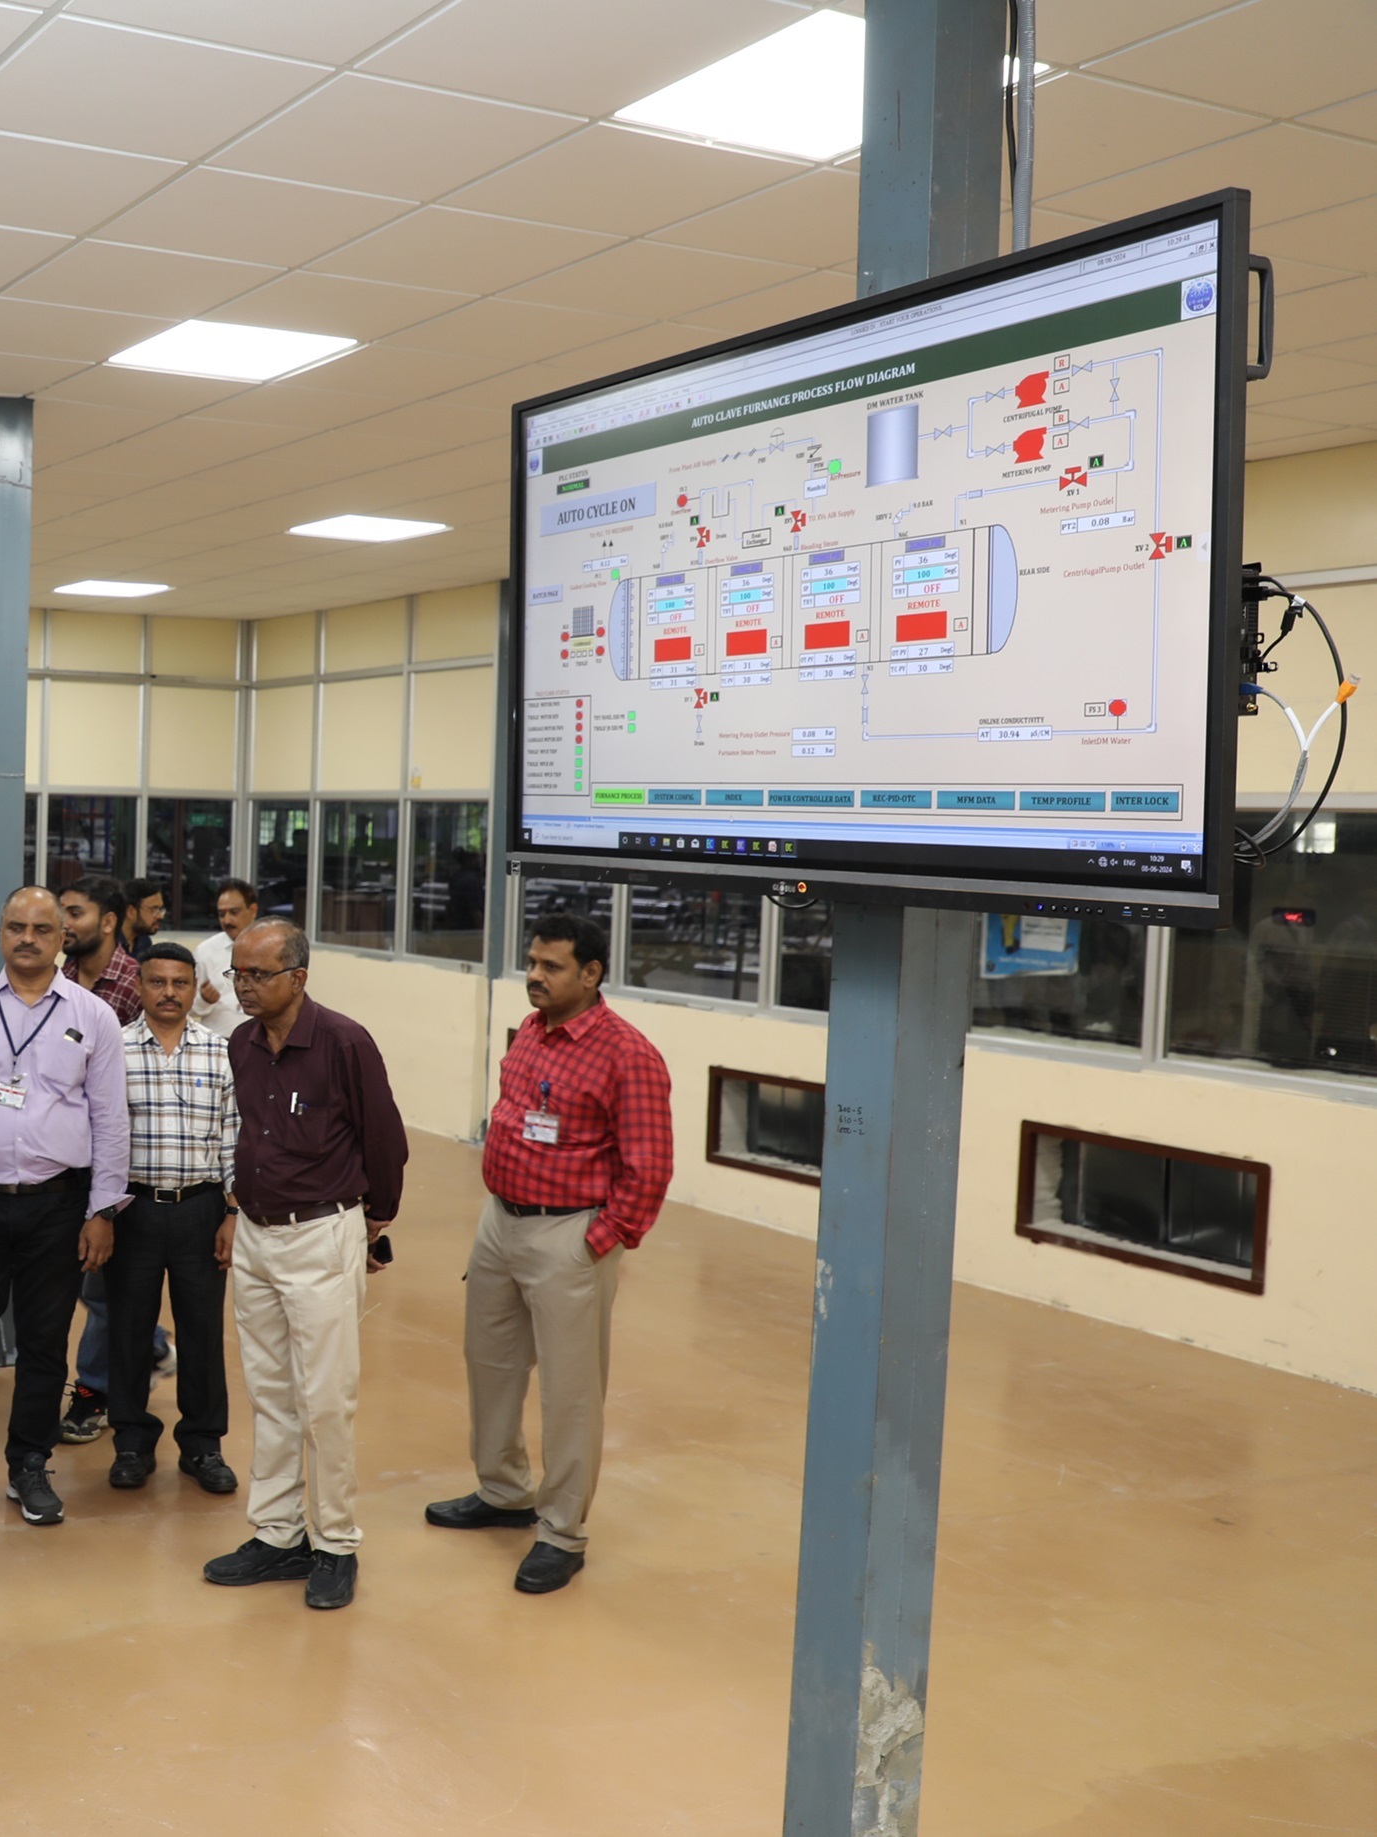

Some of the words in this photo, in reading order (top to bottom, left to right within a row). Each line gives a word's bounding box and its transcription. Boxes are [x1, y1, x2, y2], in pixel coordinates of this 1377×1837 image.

[691, 414, 714, 428] AUTO
[716, 407, 742, 421] CLAVE
[743, 395, 790, 415] FURNANCE
[792, 383, 833, 404] PROCESS
[835, 376, 864, 392] FLOW
[866, 363, 916, 385] DIAGRAM
[867, 402, 877, 410] DM
[880, 395, 904, 406] WATER
[905, 391, 924, 401] TANK
[1003, 408, 1044, 423] CENTRIFUGAL
[1058, 414, 1064, 422] R
[1002, 467, 1033, 479] METERING
[1034, 464, 1051, 474] PUMP
[557, 508, 585, 525] AUTO
[587, 500, 618, 519] CYCLE
[620, 497, 636, 512] ON
[1040, 504, 1070, 515] Metering
[1072, 501, 1092, 511] Pump
[1062, 522, 1076, 531] PT2
[1091, 518, 1110, 527] 0.08
[918, 556, 928, 564] 36
[1123, 563, 1145, 571] Outlet
[917, 571, 931, 579] 100
[823, 582, 835, 590] 100
[924, 584, 941, 594] OFF
[829, 595, 844, 604] OFF
[746, 604, 760, 613] OFF
[907, 600, 940, 610] REMOTE
[670, 613, 682, 621] OFF
[816, 609, 845, 619] REMOTE
[735, 618, 762, 627] REMOTE
[664, 626, 687, 635] REMOTE
[919, 648, 929, 656] 27
[1000, 717, 1044, 725] CONDUCTIVITY
[998, 731, 1020, 739] 30.94
[792, 795, 834, 803] CONTROLLER
[873, 795, 916, 803] REC-PID-OTC
[957, 796, 975, 804] MFM
[976, 796, 995, 804] DATA
[1031, 797, 1056, 805] TEMP
[1056, 797, 1091, 806] PROFILE
[1116, 797, 1143, 805] INTER
[1145, 797, 1169, 806] LOCK
[1141, 865, 1172, 873] 08-06-2024
